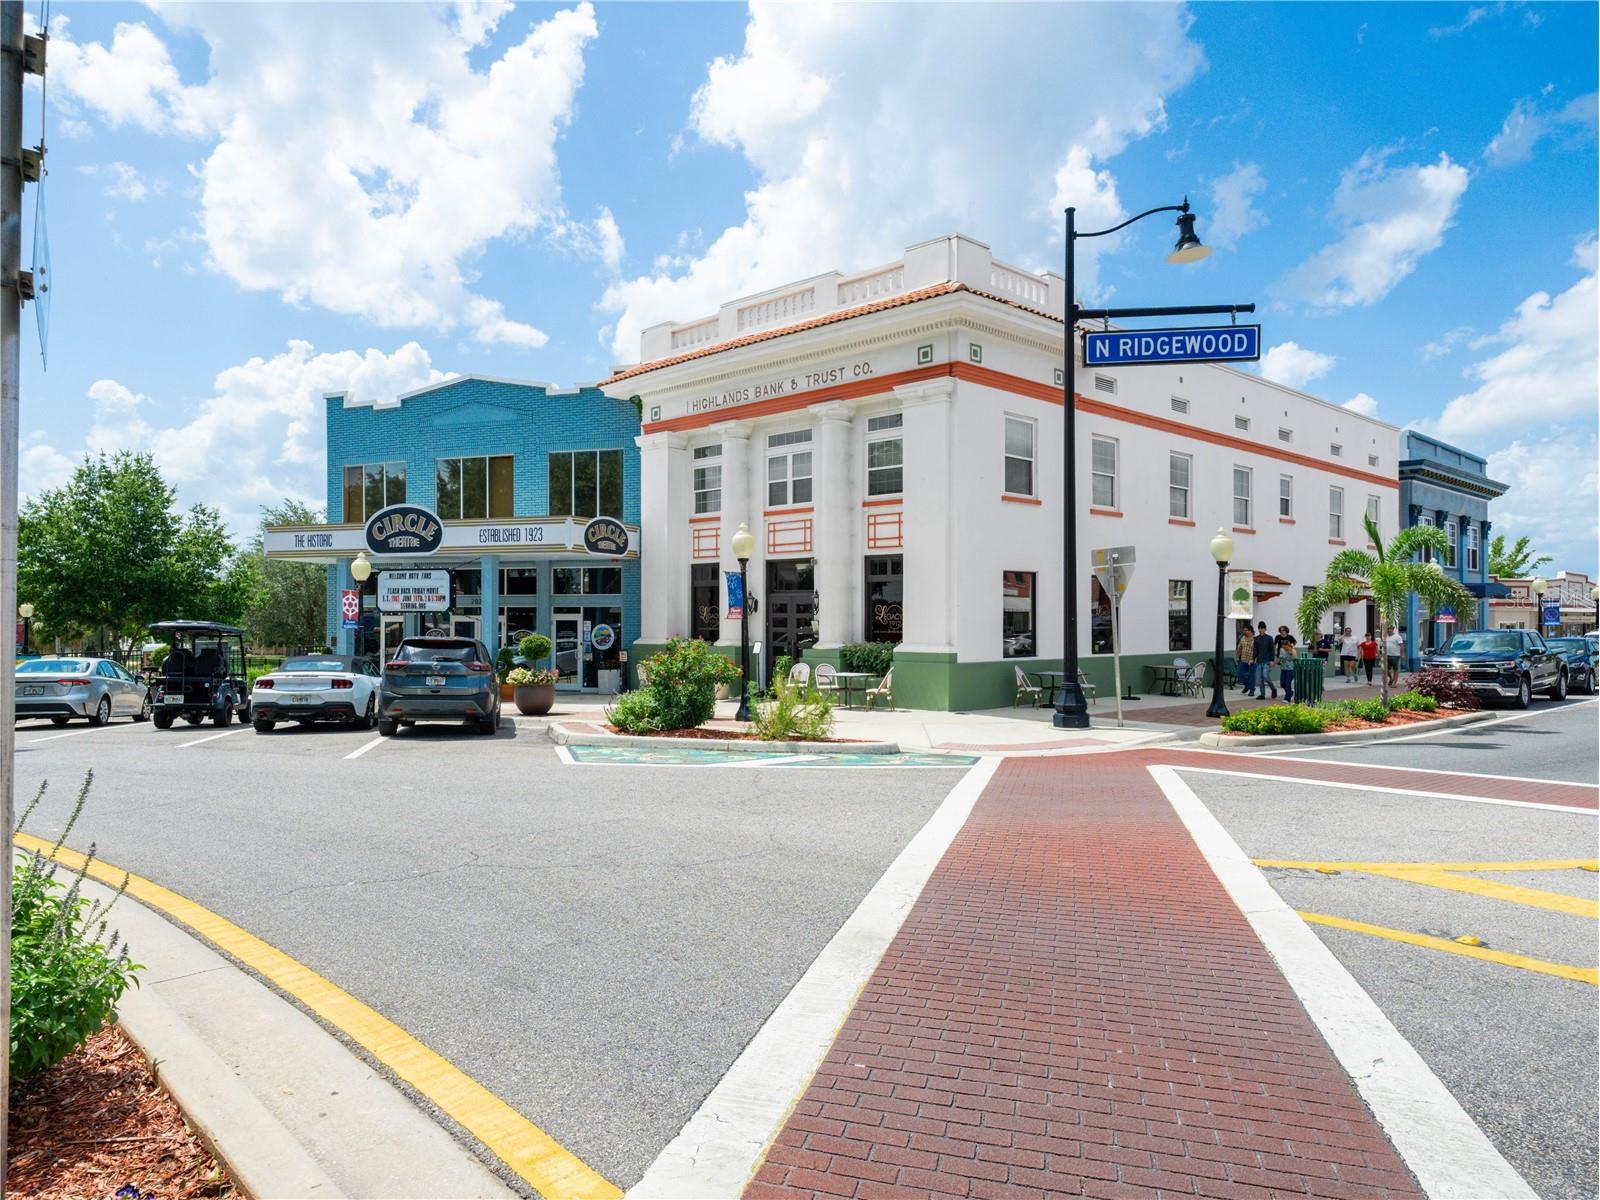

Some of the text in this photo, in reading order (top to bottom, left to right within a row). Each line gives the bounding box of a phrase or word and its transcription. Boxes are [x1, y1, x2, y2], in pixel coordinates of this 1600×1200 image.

[1096, 334, 1248, 358] N RIDGEWOOD
[692, 362, 873, 412] HIGHLANDS BANK & TRUST CO.
[372, 513, 439, 542] CIRCLE
[479, 527, 543, 543] ESTABLISHED 1923
[588, 523, 627, 548] CIRCLE
[294, 534, 333, 548] THE HISTORIC
[388, 536, 420, 548] THEATRE
